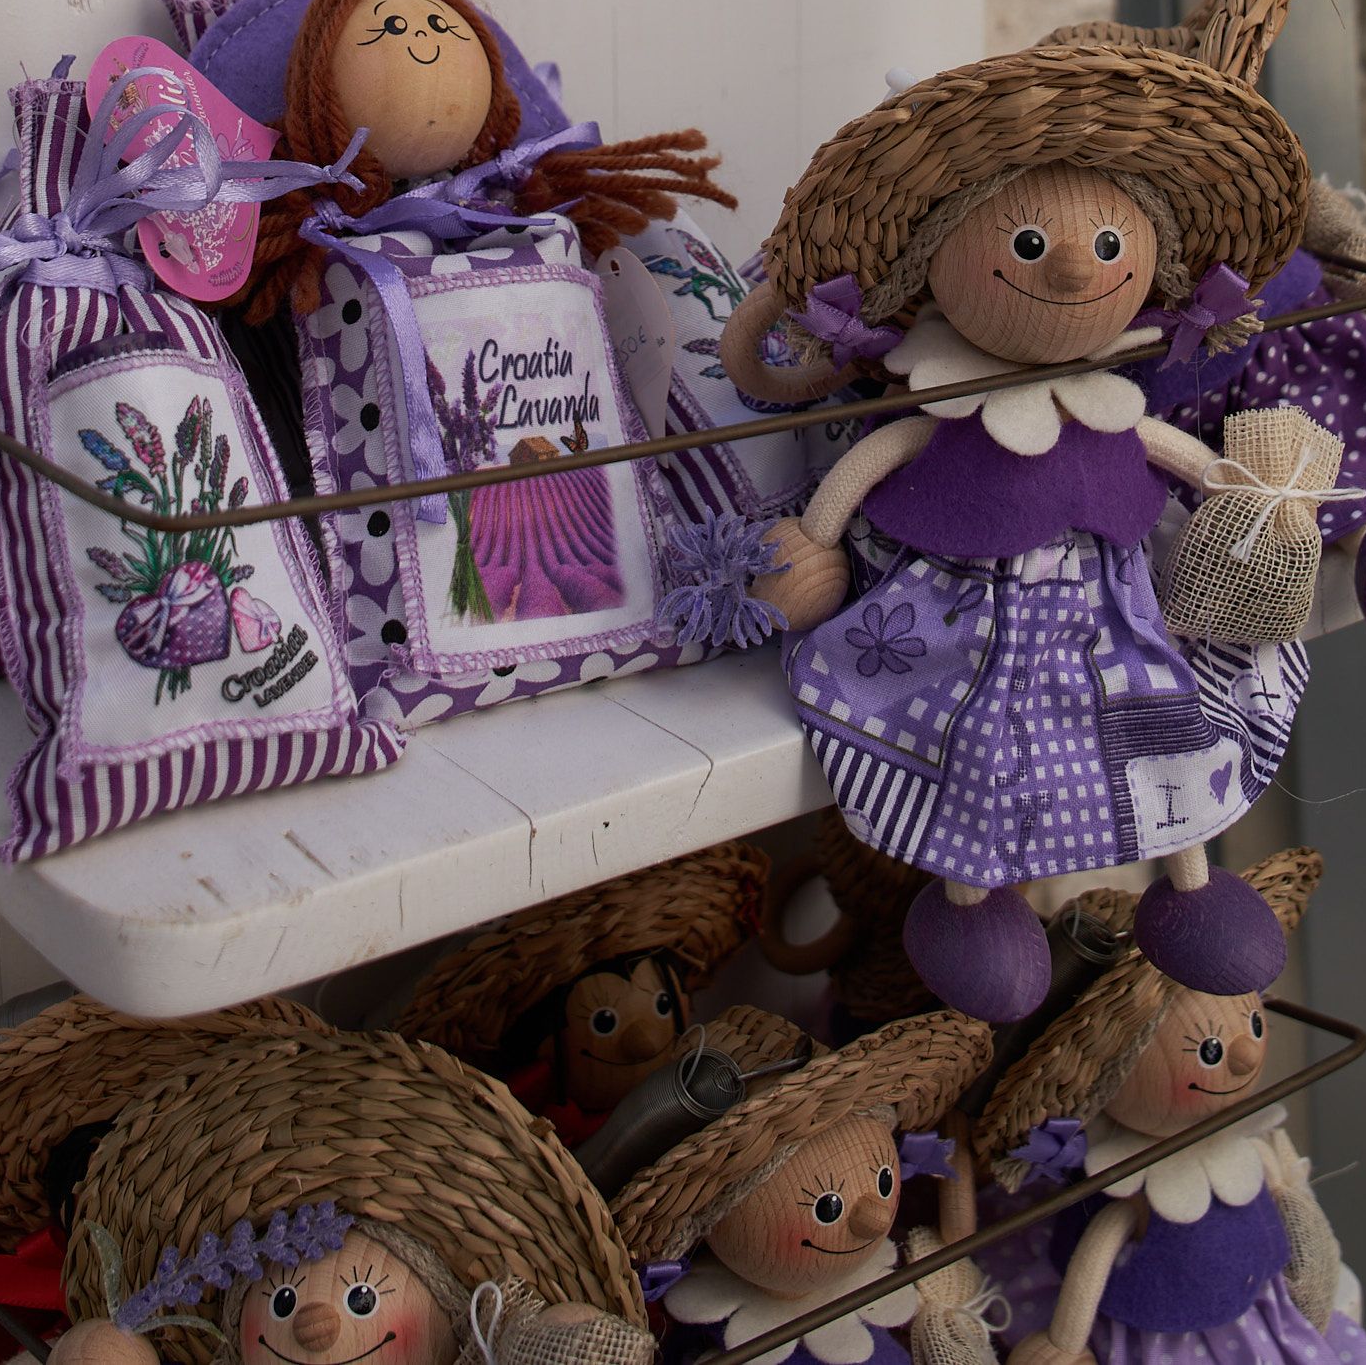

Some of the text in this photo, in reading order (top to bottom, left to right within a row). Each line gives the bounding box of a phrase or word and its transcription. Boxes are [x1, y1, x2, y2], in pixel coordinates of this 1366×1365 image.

[479, 337, 573, 383] Croatia
[496, 371, 600, 429] Lavanda
[253, 649, 319, 708] LAVENDER
